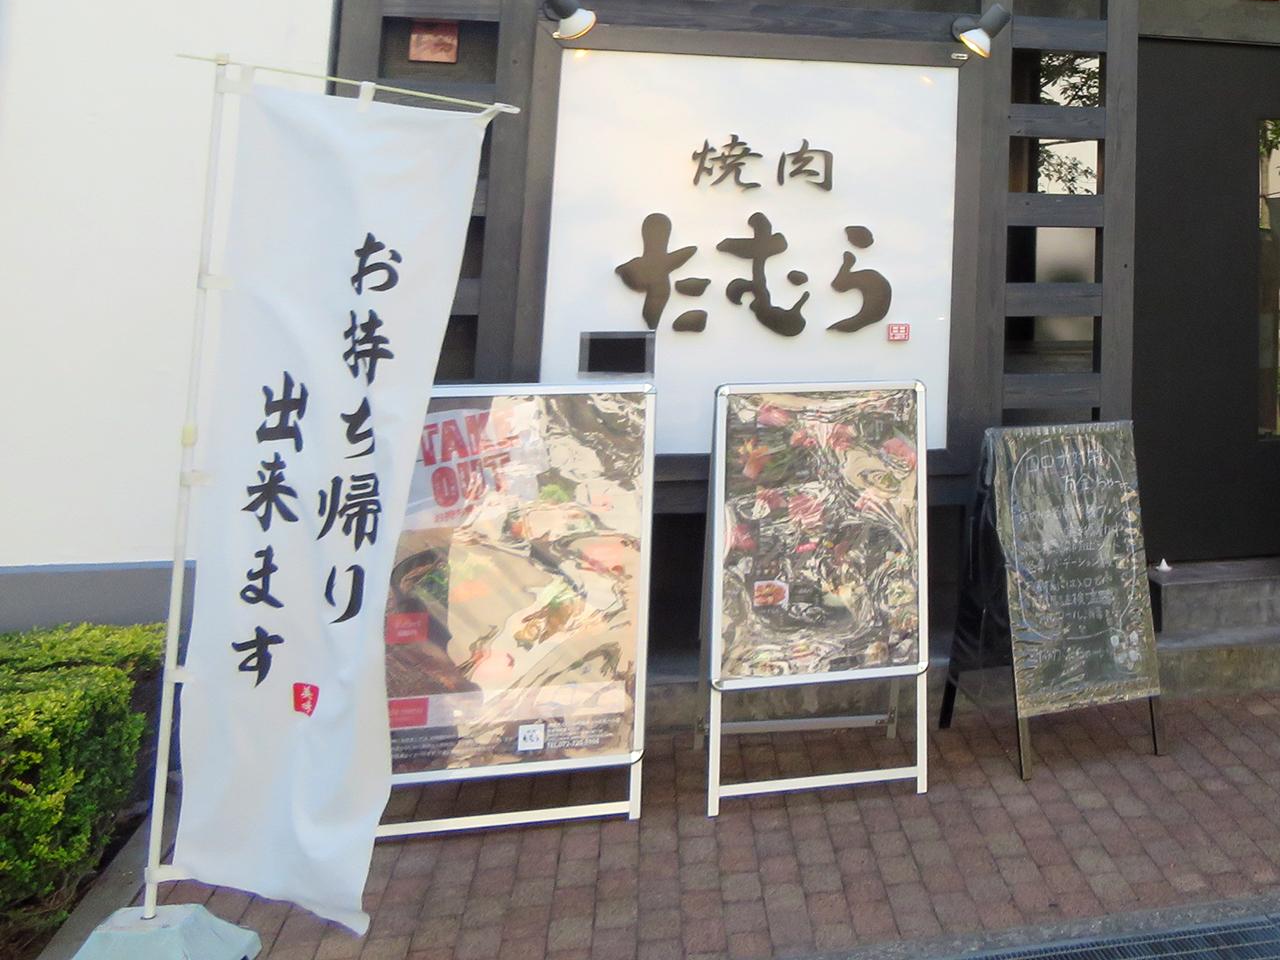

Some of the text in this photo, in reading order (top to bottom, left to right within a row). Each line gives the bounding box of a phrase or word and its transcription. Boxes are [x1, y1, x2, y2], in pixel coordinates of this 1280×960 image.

[691, 134, 834, 191] 焼肉
[614, 212, 893, 337] たむら
[231, 370, 309, 688] 出来ます
[316, 231, 403, 624] お持ち帰り
